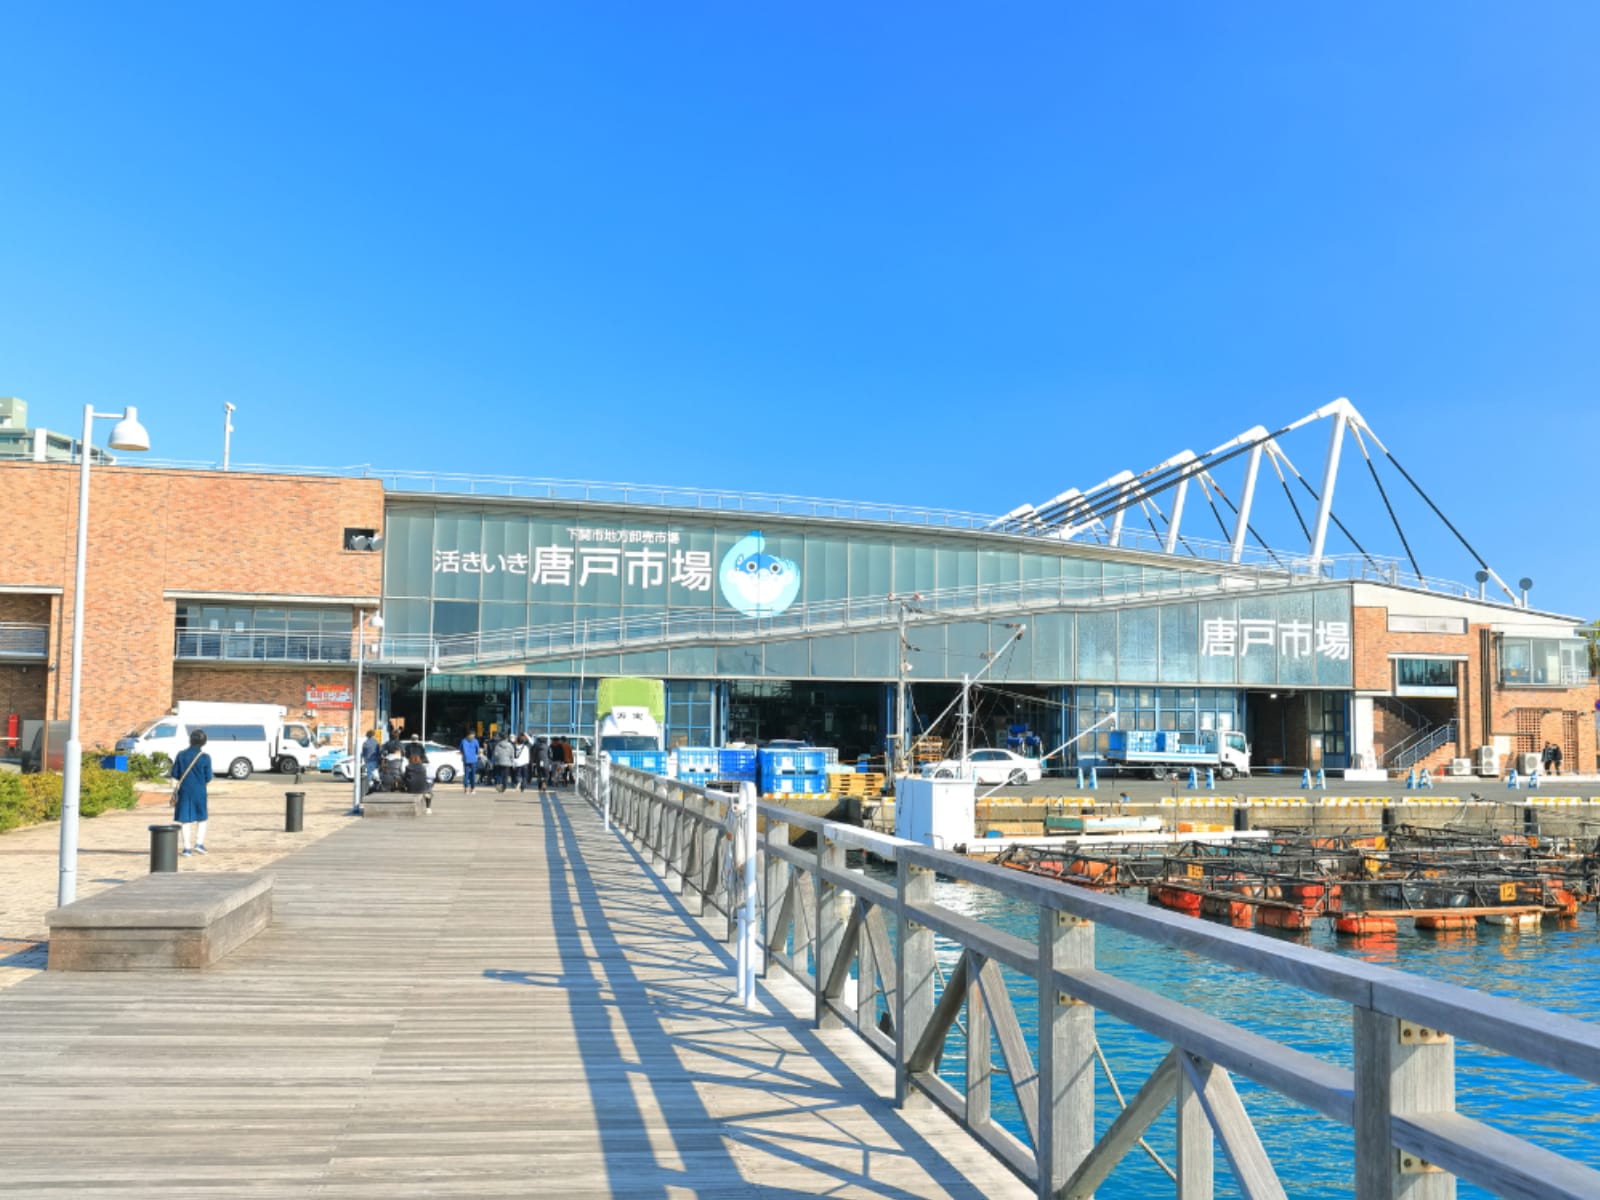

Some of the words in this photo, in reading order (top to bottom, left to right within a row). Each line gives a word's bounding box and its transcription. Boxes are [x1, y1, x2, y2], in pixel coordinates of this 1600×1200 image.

[434, 549, 528, 574] 活きいき
[532, 543, 712, 591] 唐戸市場
[1201, 617, 1350, 660] 唐戸市場
